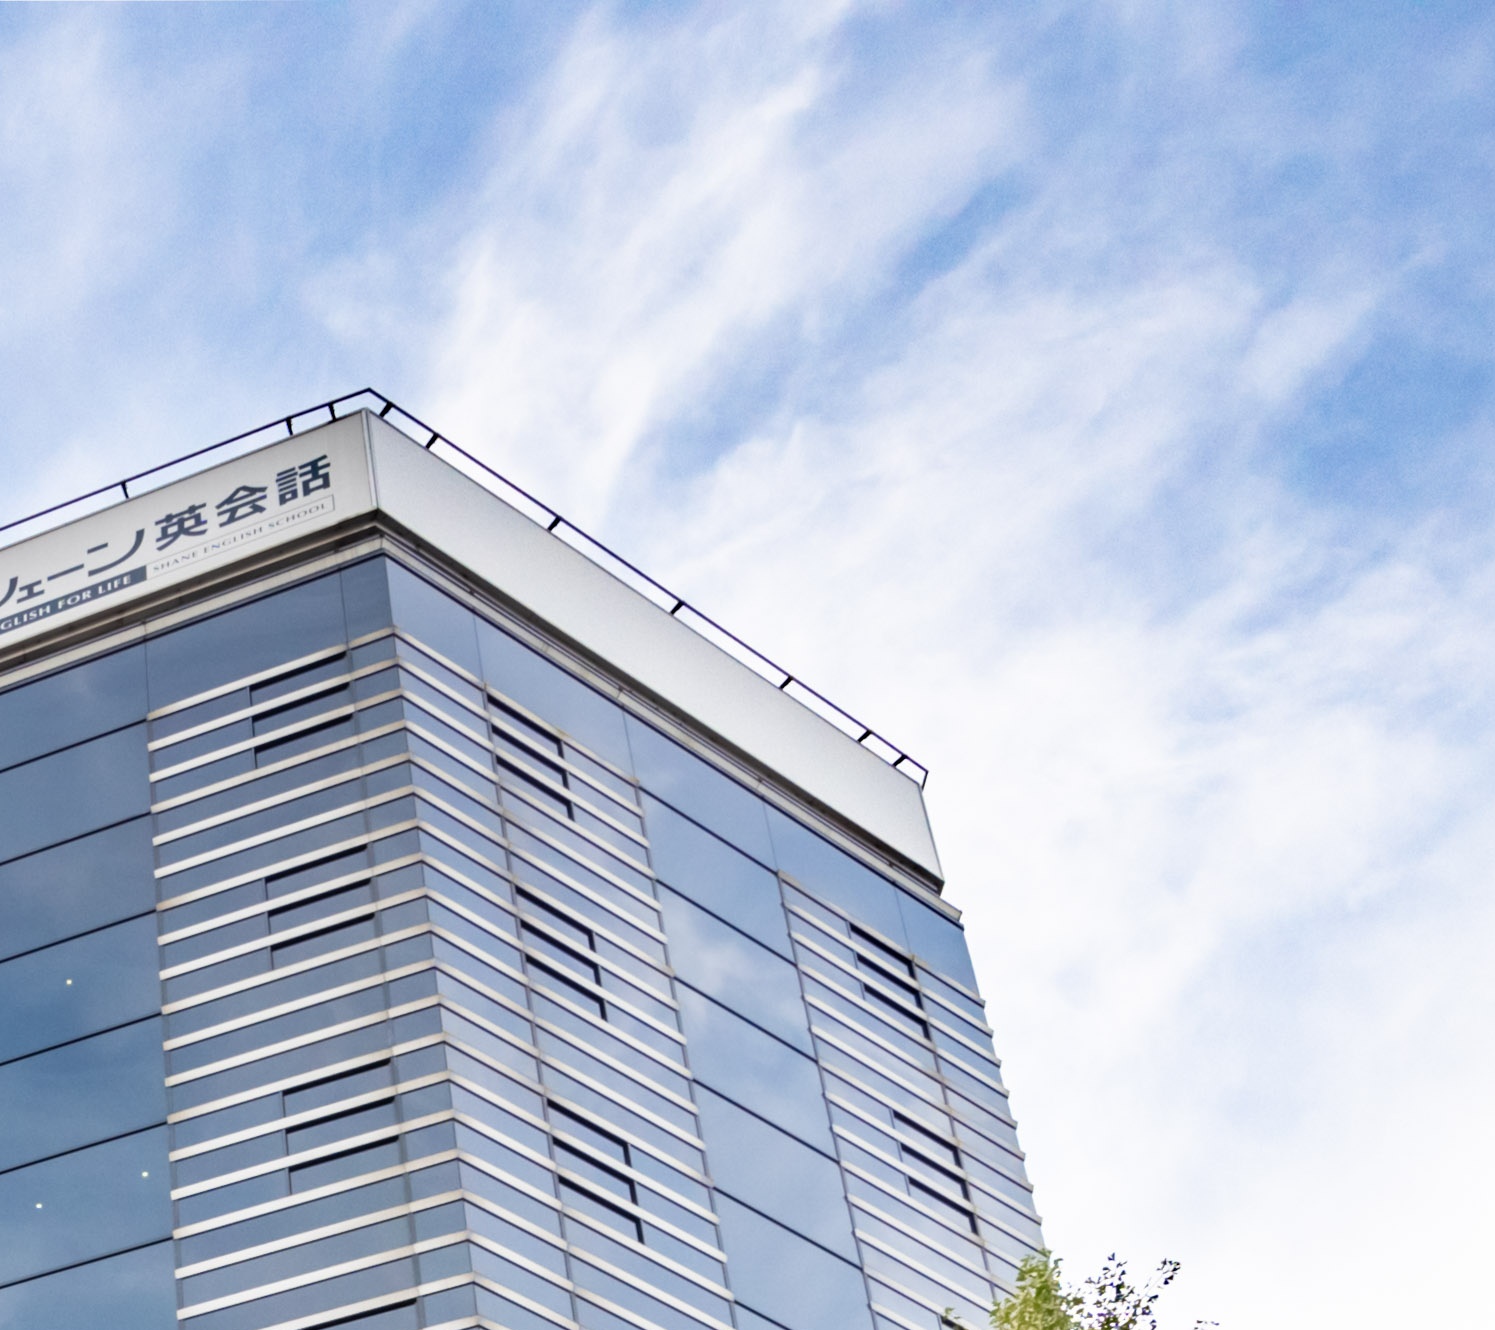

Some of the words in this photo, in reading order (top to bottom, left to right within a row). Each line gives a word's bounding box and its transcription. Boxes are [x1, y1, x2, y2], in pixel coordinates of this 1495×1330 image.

[153, 548, 199, 574] SHANE
[203, 526, 264, 555] ENGLISH
[267, 502, 329, 531] SCHOOL
[57, 588, 92, 612] FOR
[97, 573, 132, 600] LIFE
